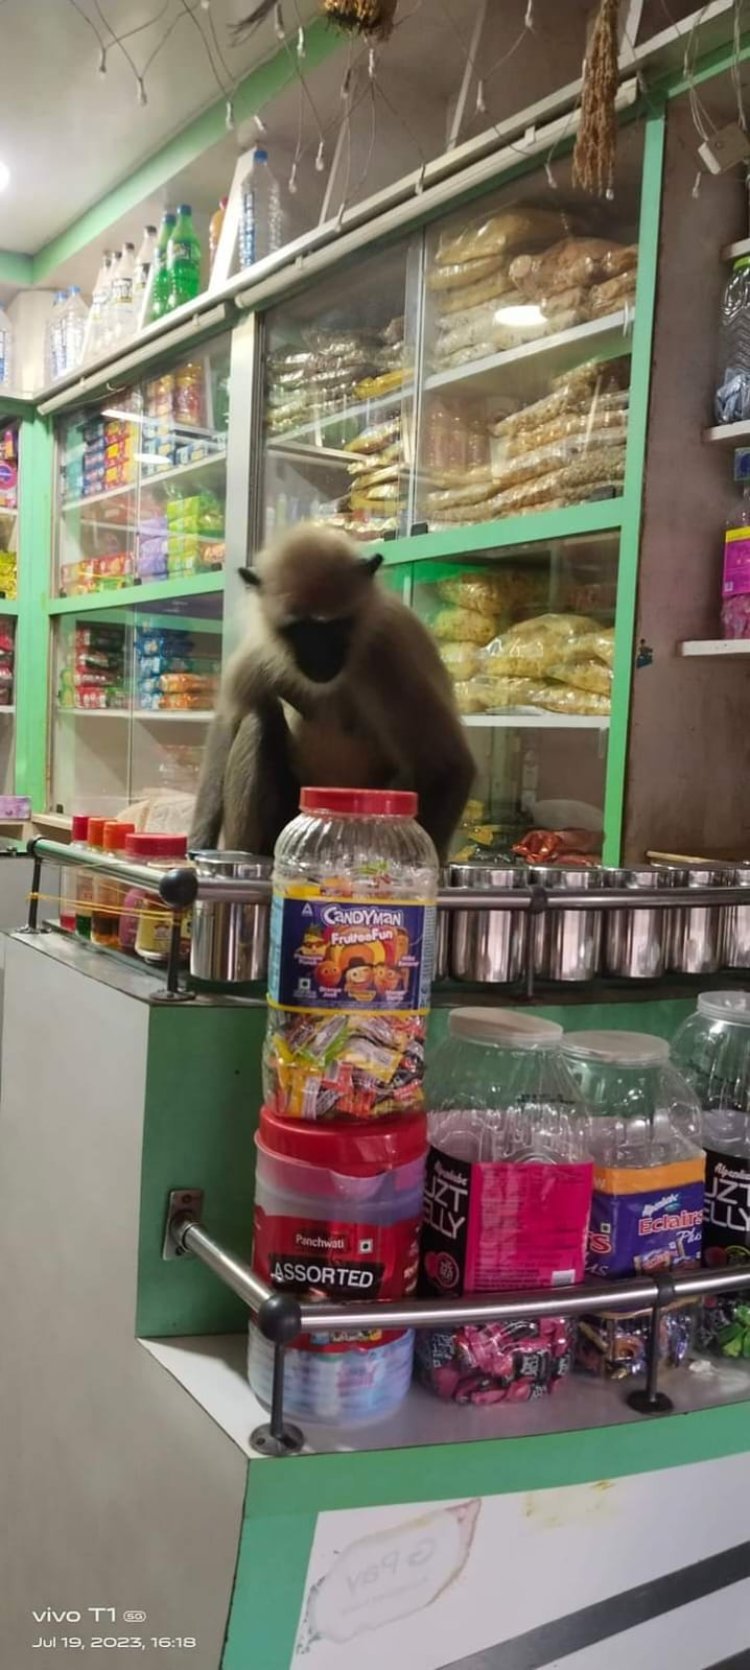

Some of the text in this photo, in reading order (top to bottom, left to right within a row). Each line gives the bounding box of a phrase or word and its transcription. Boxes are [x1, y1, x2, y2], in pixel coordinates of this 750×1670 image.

[638, 1208, 703, 1236] Eclairs
[296, 1234, 345, 1249] Panchwati
[274, 1262, 374, 1289] ASSORTED
